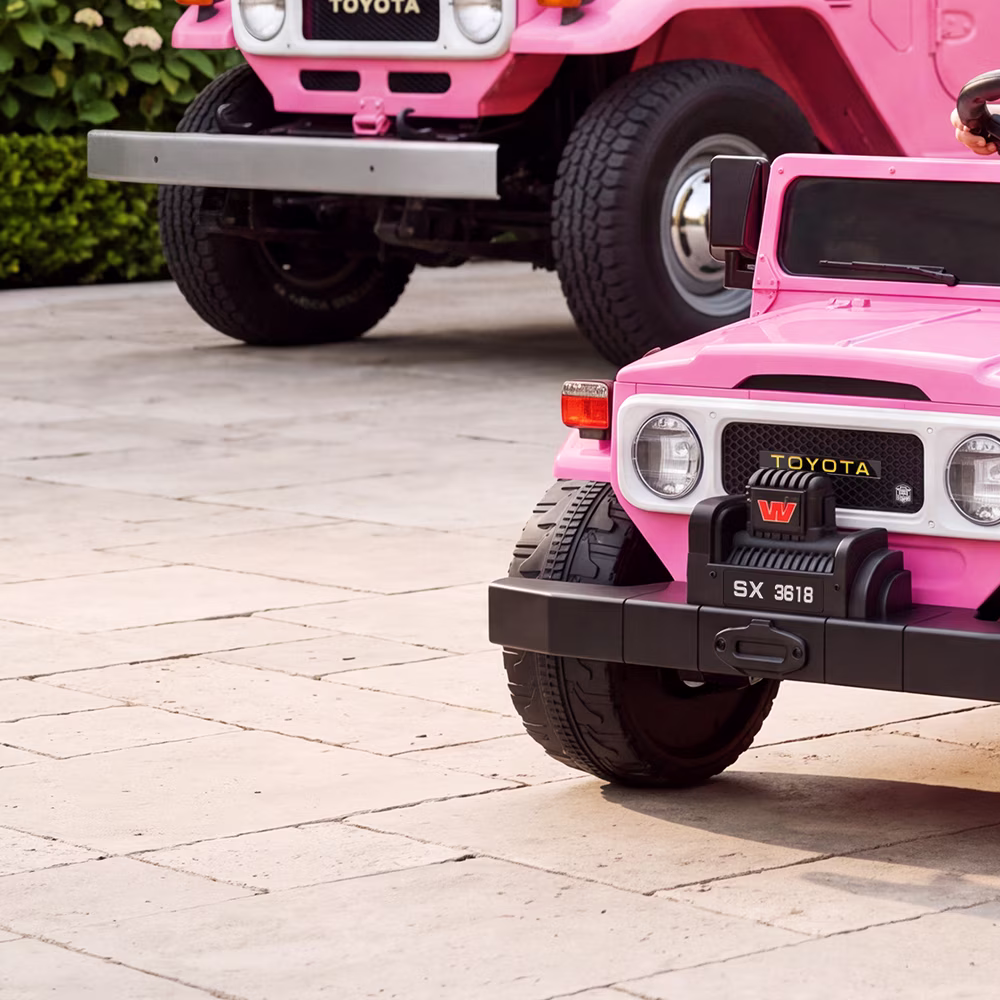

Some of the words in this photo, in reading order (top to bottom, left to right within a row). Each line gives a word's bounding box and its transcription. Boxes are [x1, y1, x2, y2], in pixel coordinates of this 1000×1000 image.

[771, 454, 870, 475] TOYOTA
[757, 500, 797, 523] W
[733, 580, 764, 599] SX
[774, 584, 814, 604] 3618
